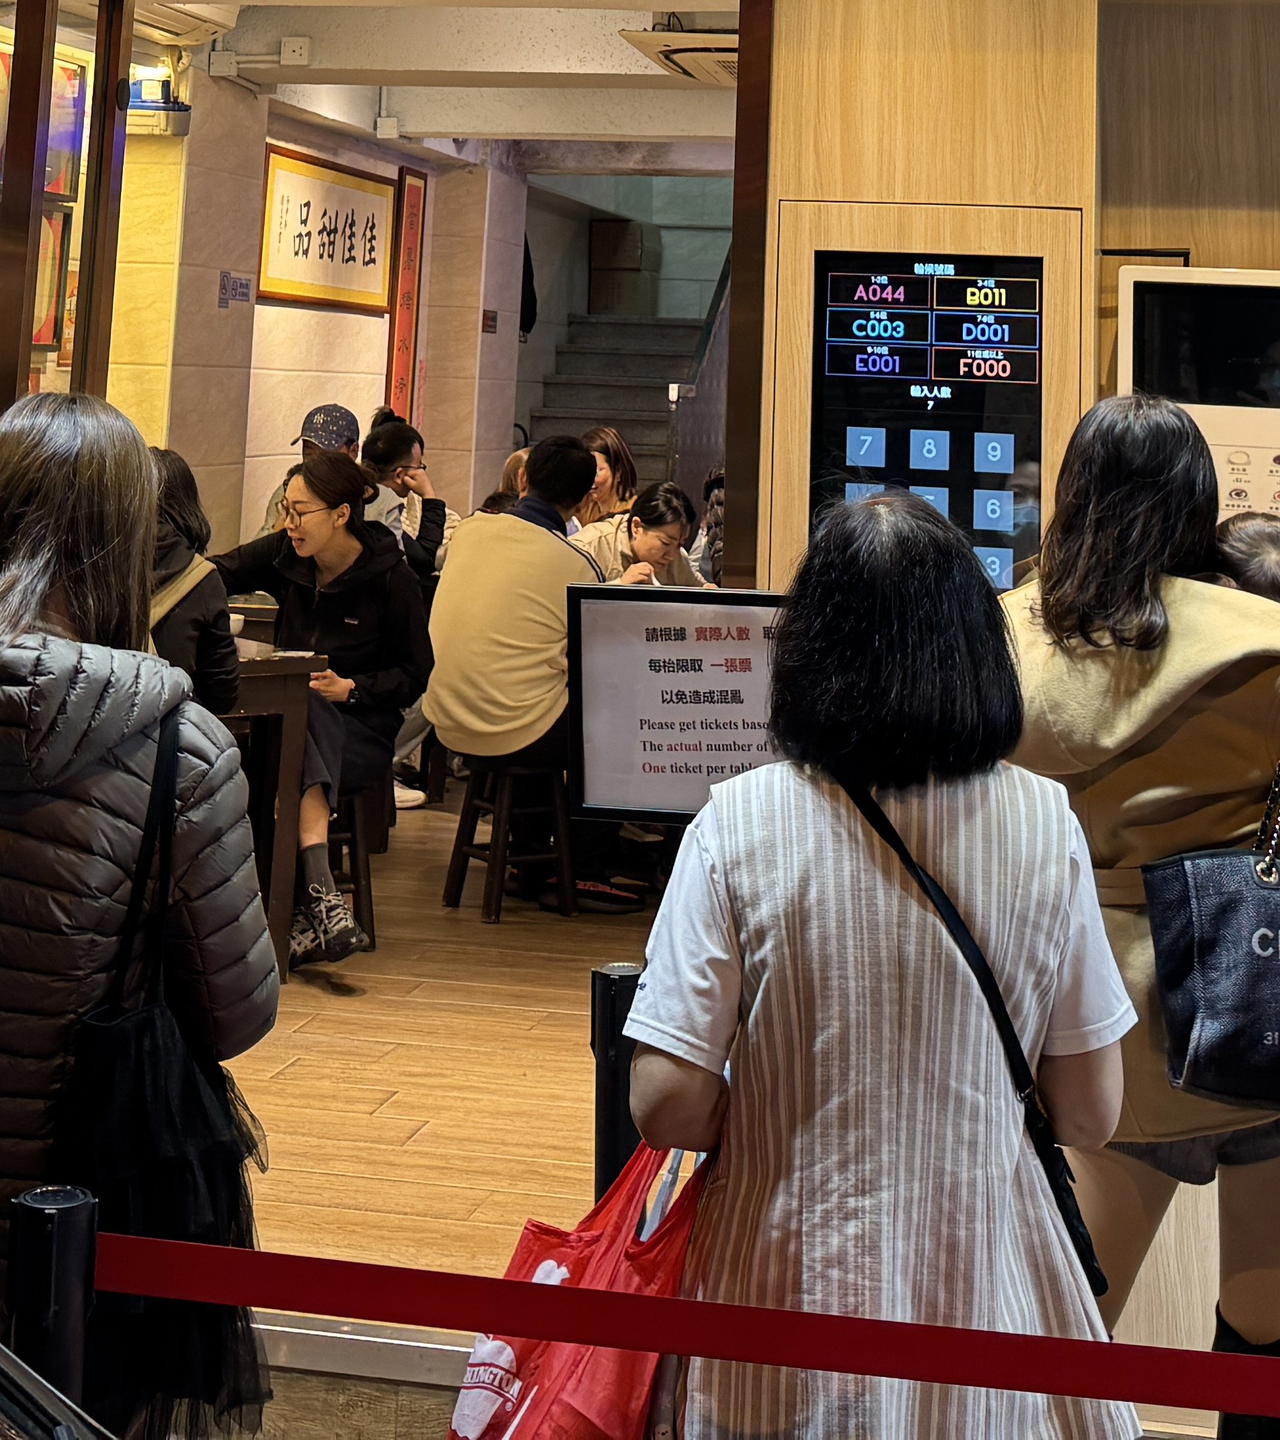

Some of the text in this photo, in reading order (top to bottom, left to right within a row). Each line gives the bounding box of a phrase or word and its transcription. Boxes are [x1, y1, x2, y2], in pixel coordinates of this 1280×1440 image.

[854, 285, 905, 302] A044
[966, 288, 1006, 306] B011
[852, 319, 904, 338] C003
[962, 323, 1009, 342] D001
[855, 355, 900, 373] E001
[959, 358, 1011, 377] F000
[860, 435, 1001, 461] 7 8 9
[987, 499, 1001, 518] 6
[986, 557, 1000, 576] 3
[645, 627, 687, 642] 請根據
[695, 627, 750, 641] 實際人數
[710, 658, 752, 673] 一張票
[661, 690, 744, 705] 以免造成混亂
[639, 718, 675, 731] Please
[679, 720, 697, 732] get
[700, 719, 739, 731] tickets
[640, 740, 769, 753] The actual number of
[642, 762, 667, 774] One
[670, 762, 703, 774] ticket
[706, 764, 726, 777] per
[1264, 1032, 1278, 1045] 31
